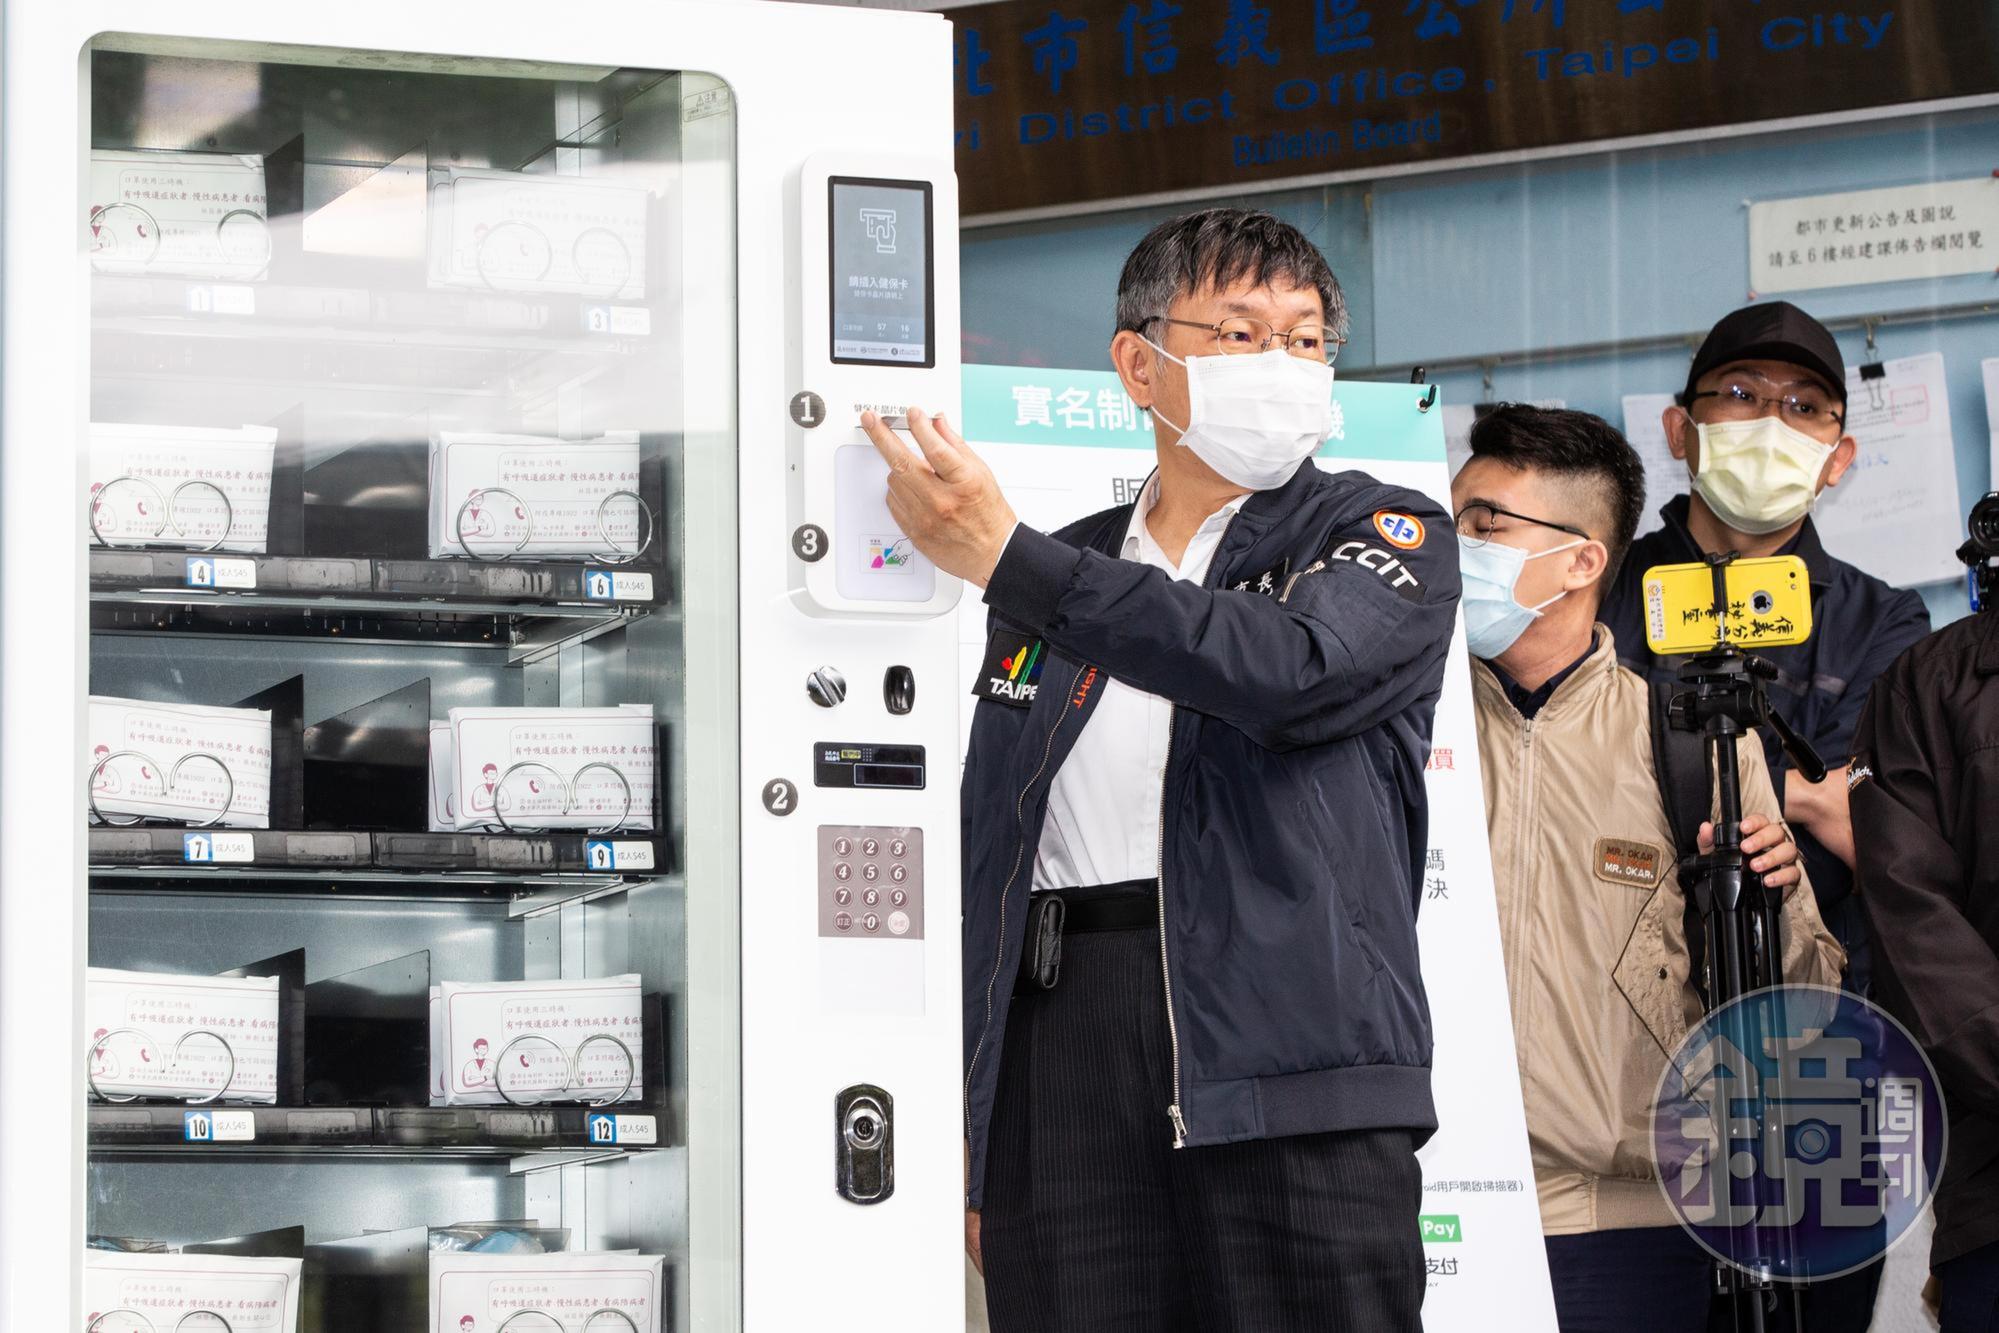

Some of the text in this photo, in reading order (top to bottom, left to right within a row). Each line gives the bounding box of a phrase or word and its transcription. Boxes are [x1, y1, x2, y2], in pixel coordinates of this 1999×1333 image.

[1020, 91, 1235, 145] District
[1526, 28, 1719, 80] Taipei
[1762, 14, 1893, 51] City
[1233, 111, 1441, 167] Bulletin Board
[1796, 205, 1956, 236] 都市更新公告及圖說
[848, 276, 909, 290] 請插入健保卡
[594, 312, 602, 329] 3
[800, 396, 815, 422] 1
[1012, 385, 1154, 432] 實名制
[802, 529, 818, 555] 3
[197, 565, 205, 582] 4
[1332, 541, 1418, 588] CCIT
[597, 579, 604, 595] 6
[1427, 749, 1455, 769] 買
[772, 783, 788, 809] 2
[195, 841, 202, 858] 7
[866, 841, 875, 854] 2
[894, 842, 903, 855] 3
[598, 849, 605, 866] 9
[839, 866, 903, 880] 4 5 6
[1604, 862, 1622, 874] MR.
[840, 890, 903, 904] 7 8 9
[1426, 877, 1448, 899] 決
[867, 916, 875, 928] 0
[192, 1119, 206, 1137] 10
[597, 1122, 610, 1139] 12
[1423, 1220, 1456, 1239] Pay
[1426, 1257, 1458, 1275] 支付
